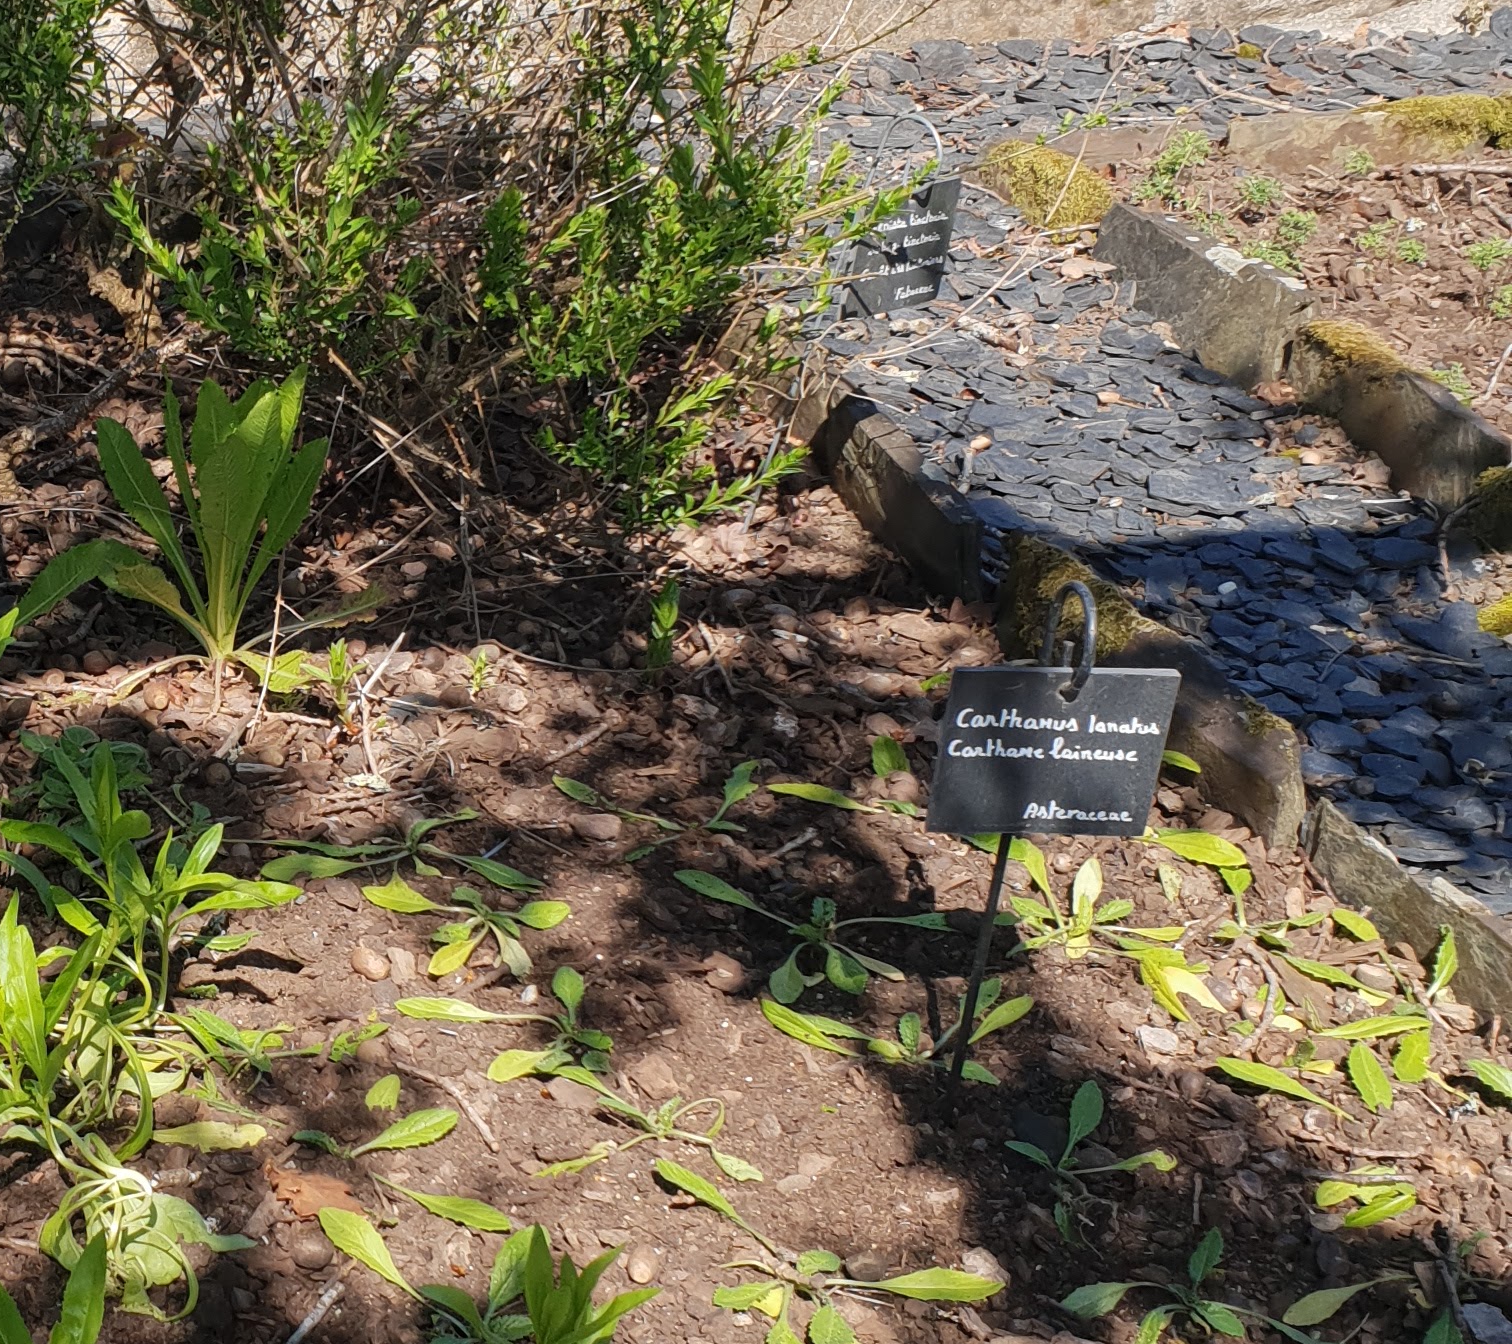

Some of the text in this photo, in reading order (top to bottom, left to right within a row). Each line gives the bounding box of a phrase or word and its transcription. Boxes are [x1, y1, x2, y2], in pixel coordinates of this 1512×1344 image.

[955, 707, 1161, 735] Carthamus lanatus
[947, 736, 1139, 762] Carthame laineuse
[1022, 799, 1134, 822] Asteraceae
